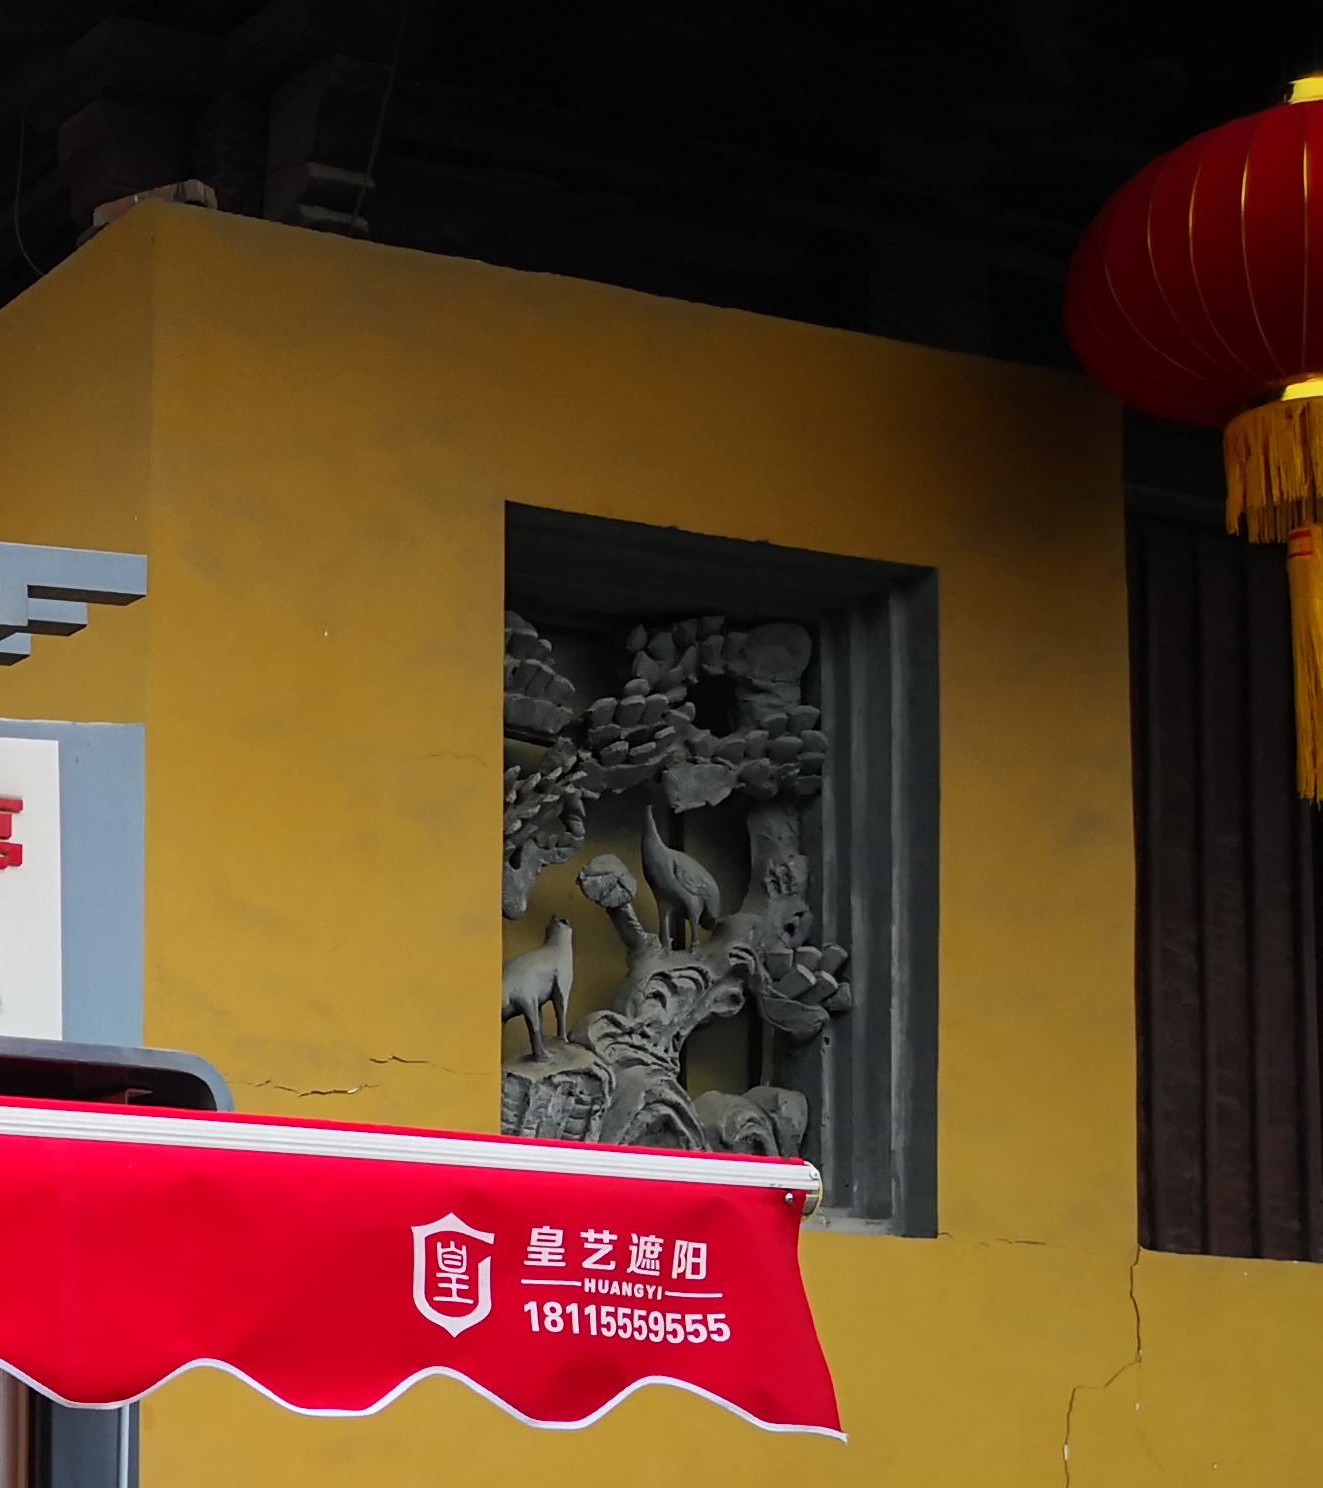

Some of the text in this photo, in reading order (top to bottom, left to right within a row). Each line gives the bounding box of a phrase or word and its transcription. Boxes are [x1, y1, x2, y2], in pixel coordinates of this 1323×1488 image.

[523, 1225, 708, 1280] 皇艺遮阳
[584, 1277, 663, 1300] HUANGYI
[523, 1301, 731, 1344] 18115559555
